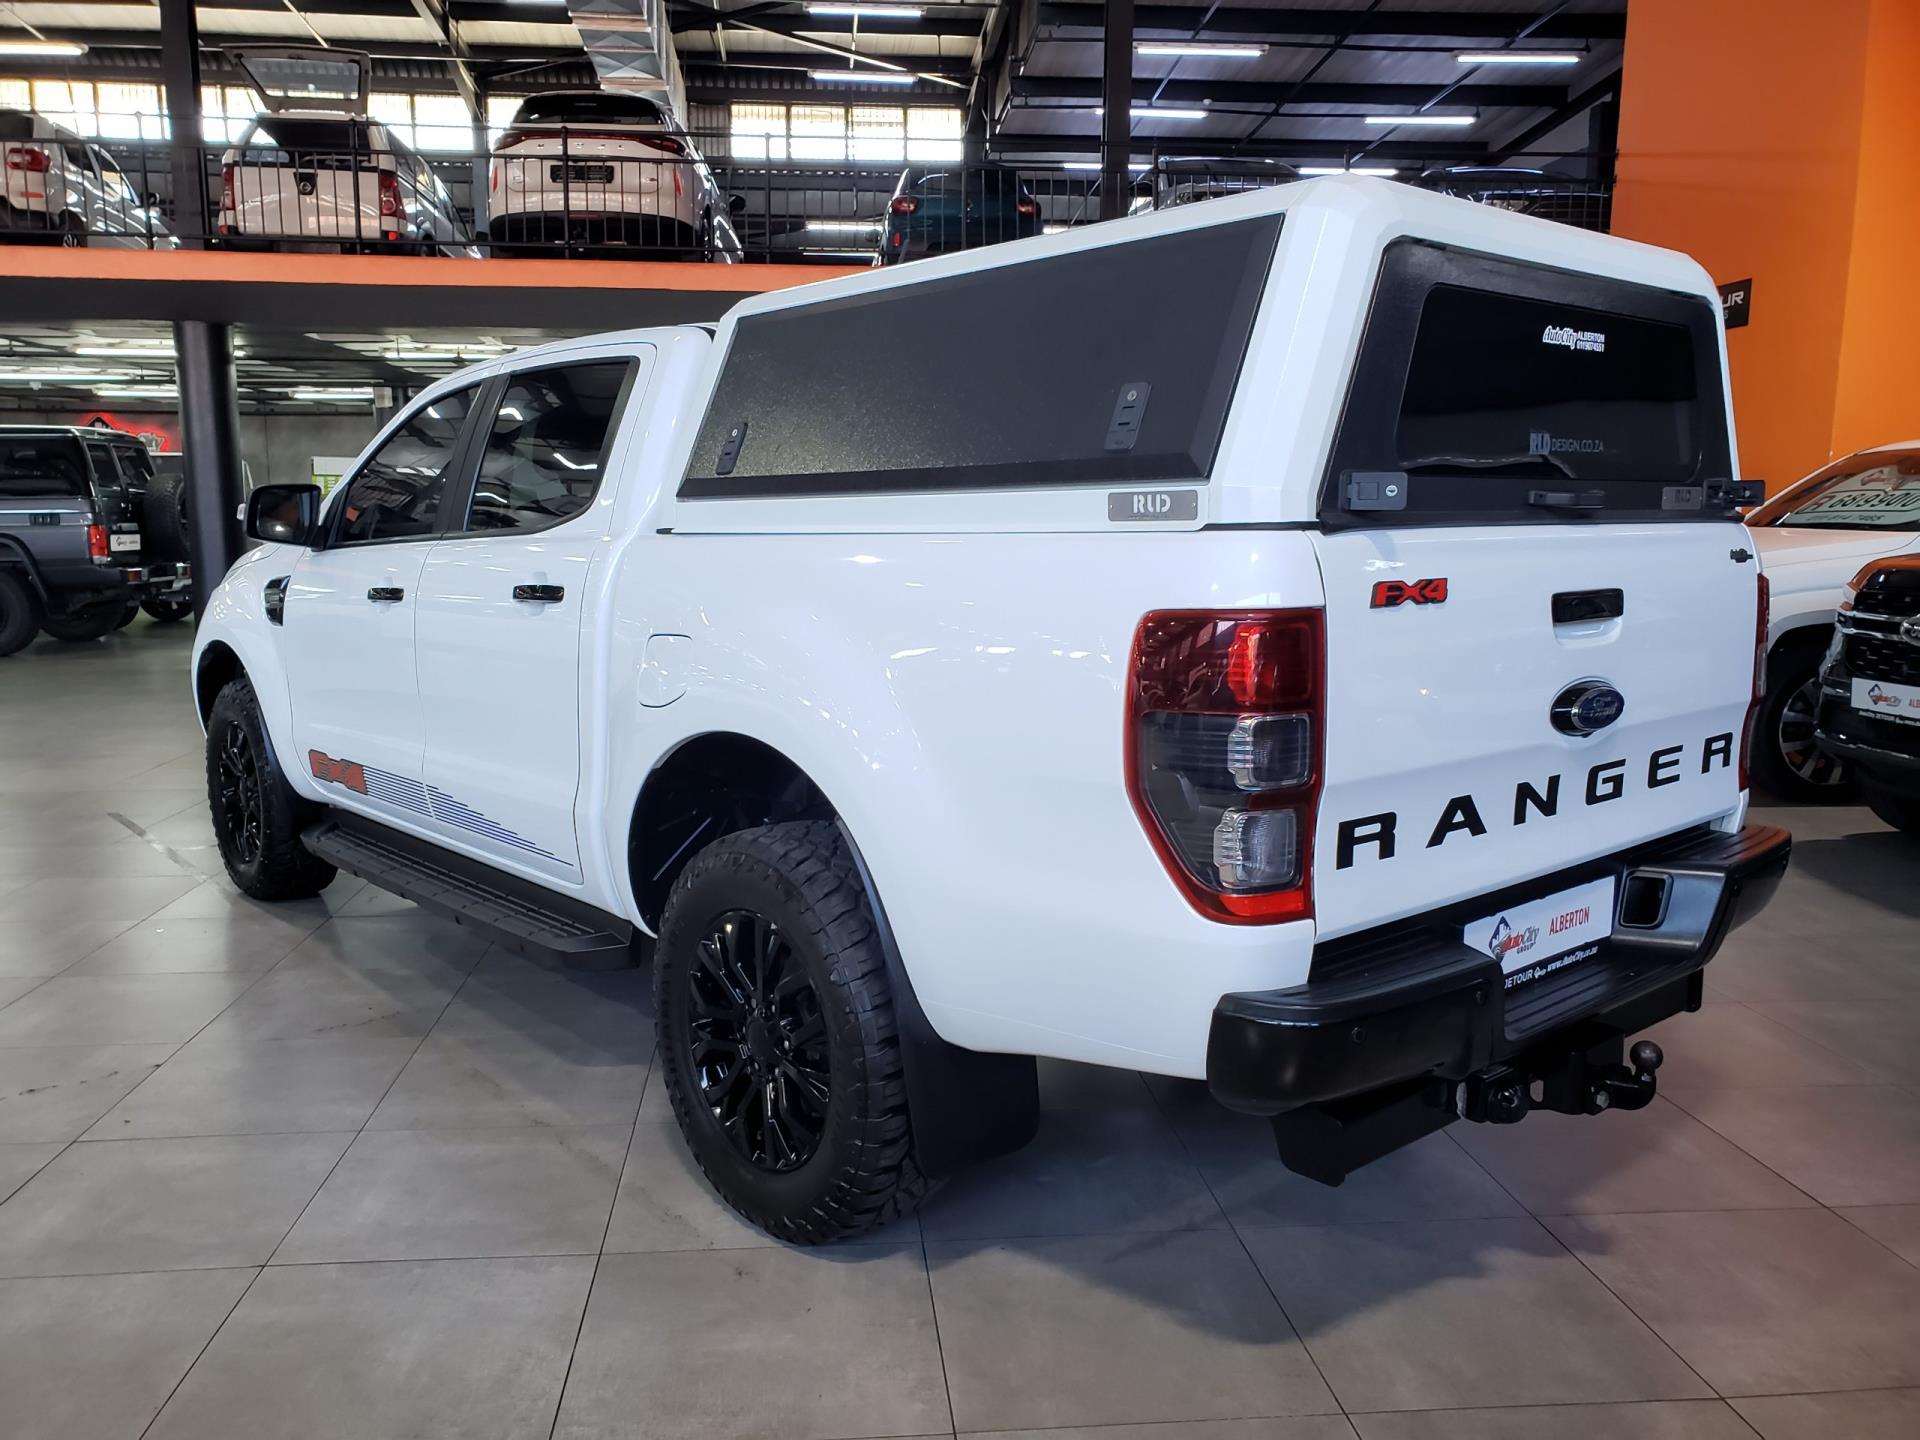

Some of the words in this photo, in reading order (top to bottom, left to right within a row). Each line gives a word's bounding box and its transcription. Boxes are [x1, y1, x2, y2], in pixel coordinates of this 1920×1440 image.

[1369, 577, 1448, 609] FX4
[1336, 731, 1733, 870] RANGER
[1548, 905, 1590, 937] ALBERTON
